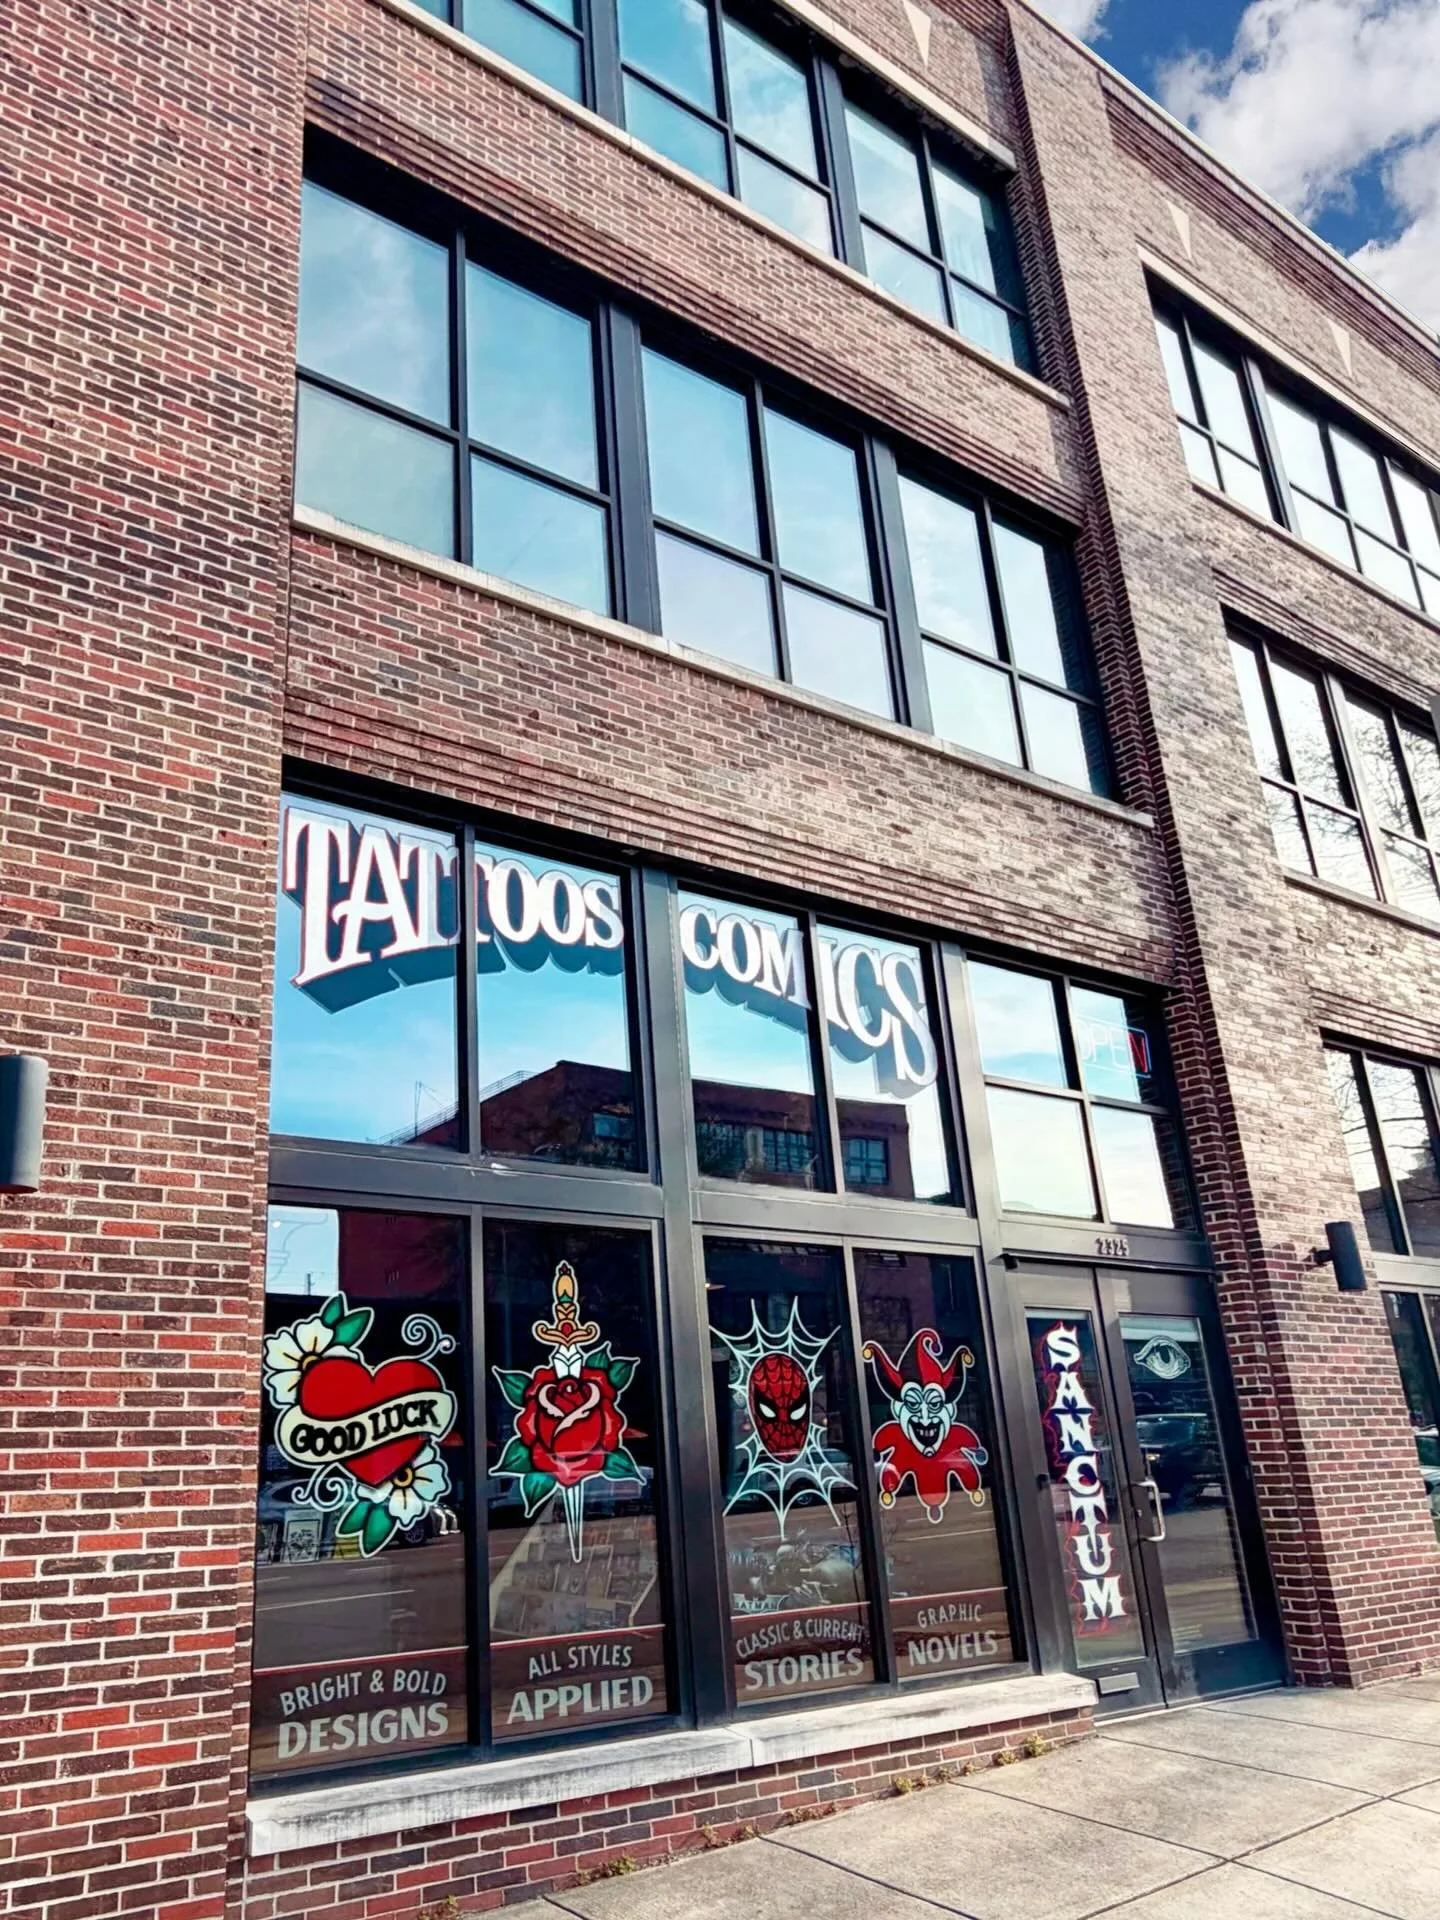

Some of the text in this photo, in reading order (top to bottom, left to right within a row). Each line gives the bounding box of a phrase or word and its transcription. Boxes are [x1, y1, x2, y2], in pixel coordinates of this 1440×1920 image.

[284, 807, 624, 986] TATTOOS
[679, 904, 938, 1086] COMICS
[289, 1399, 441, 1457] GOOD LUCK
[1045, 1325, 1127, 1622] SANCTUM
[736, 1618, 865, 1659] CLASSIC & CURRENT
[917, 1603, 983, 1629] GRAPHIC
[529, 1644, 633, 1680] ALL STYLES
[744, 1647, 864, 1692] STORIES
[907, 1629, 999, 1667] NOVELS
[279, 1668, 447, 1717] BRIGHT & BOLD
[506, 1675, 653, 1725] APPLIED
[277, 1701, 449, 1760] DESIGNS
